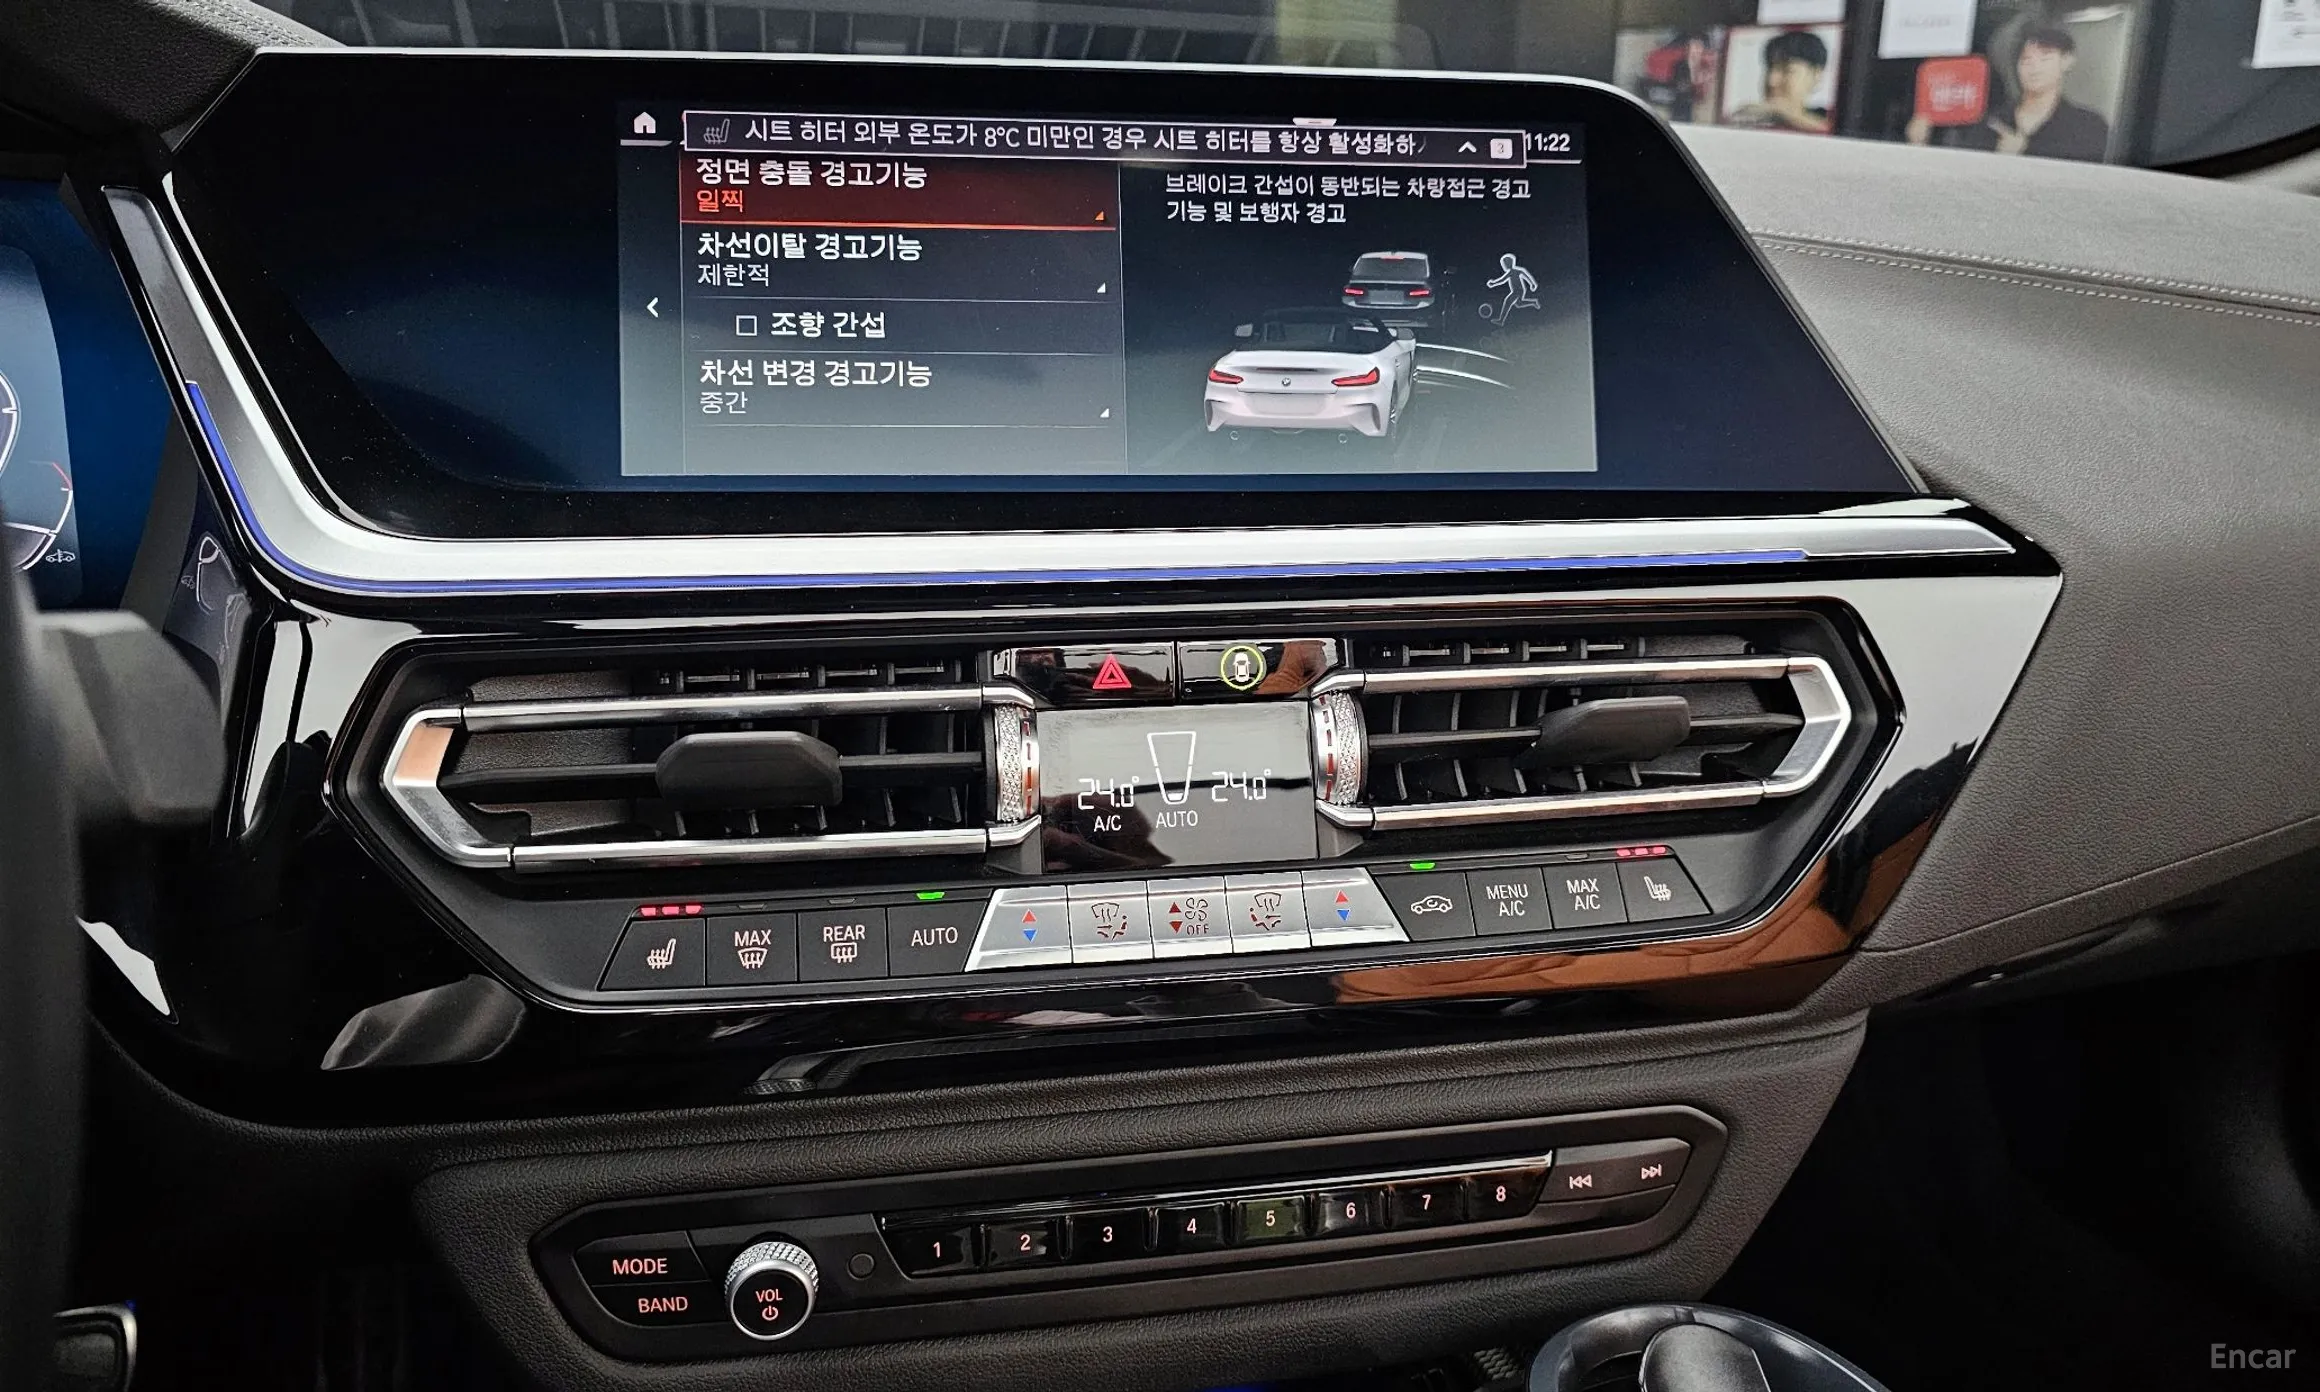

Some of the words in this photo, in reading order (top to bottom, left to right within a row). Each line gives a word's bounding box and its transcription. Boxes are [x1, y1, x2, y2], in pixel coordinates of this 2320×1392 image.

[745, 119, 793, 143] 시트
[801, 120, 847, 145] 히터
[854, 120, 901, 146] 외부
[908, 123, 977, 147] 온도가
[1027, 123, 1094, 150] 미만인
[1101, 125, 1147, 150] 경우
[1154, 127, 1199, 152] 시트
[1205, 128, 1272, 154] 히터를
[1279, 130, 1322, 155] 항상
[1328, 131, 1427, 156] 활성화하
[1525, 132, 1571, 152] 11:22
[697, 159, 750, 185] 정면
[759, 160, 812, 187] 충돌
[820, 161, 928, 189] 경고기능
[1166, 173, 1248, 197] 브레이크
[1254, 174, 1315, 198] 간섭이
[1320, 176, 1401, 199] 동반되는
[1407, 177, 1487, 200] 차량접근
[1492, 178, 1532, 200] 경고
[697, 189, 744, 213] 일찍
[1167, 200, 1207, 222] 기능
[1214, 201, 1233, 224] 및
[1240, 202, 1301, 224] 보행자
[1307, 203, 1347, 225] 경고
[698, 231, 807, 260] 차선이탈
[815, 233, 923, 261] 경고기능
[698, 263, 770, 288] 제한적
[770, 311, 825, 338] 조향
[832, 311, 887, 339] 간섭
[700, 359, 755, 386] 차선
[762, 359, 816, 387] 변경
[824, 360, 932, 388] 경고기능
[700, 390, 749, 415] 중간
[1093, 814, 1122, 833] A/C
[1155, 810, 1199, 829] AUTO
[1486, 883, 1529, 901] MENU
[1566, 878, 1599, 895] MAX
[1498, 899, 1526, 918] A/C
[1573, 892, 1601, 912] A/C
[734, 929, 773, 948] MAX
[823, 924, 866, 942] REAR
[911, 926, 959, 948] AUTO
[1186, 923, 1210, 936] OFF
[933, 1242, 942, 1259] 1
[1019, 1234, 1032, 1252] 2
[1102, 1225, 1113, 1243] 3
[1186, 1218, 1197, 1235] 4
[1265, 1210, 1276, 1227] 5
[1345, 1202, 1356, 1219] 6
[1422, 1194, 1432, 1211] 7
[1495, 1185, 1506, 1203] 8
[612, 1257, 668, 1277] MODE
[638, 1295, 689, 1315] BAND
[755, 1289, 784, 1304] VOL
